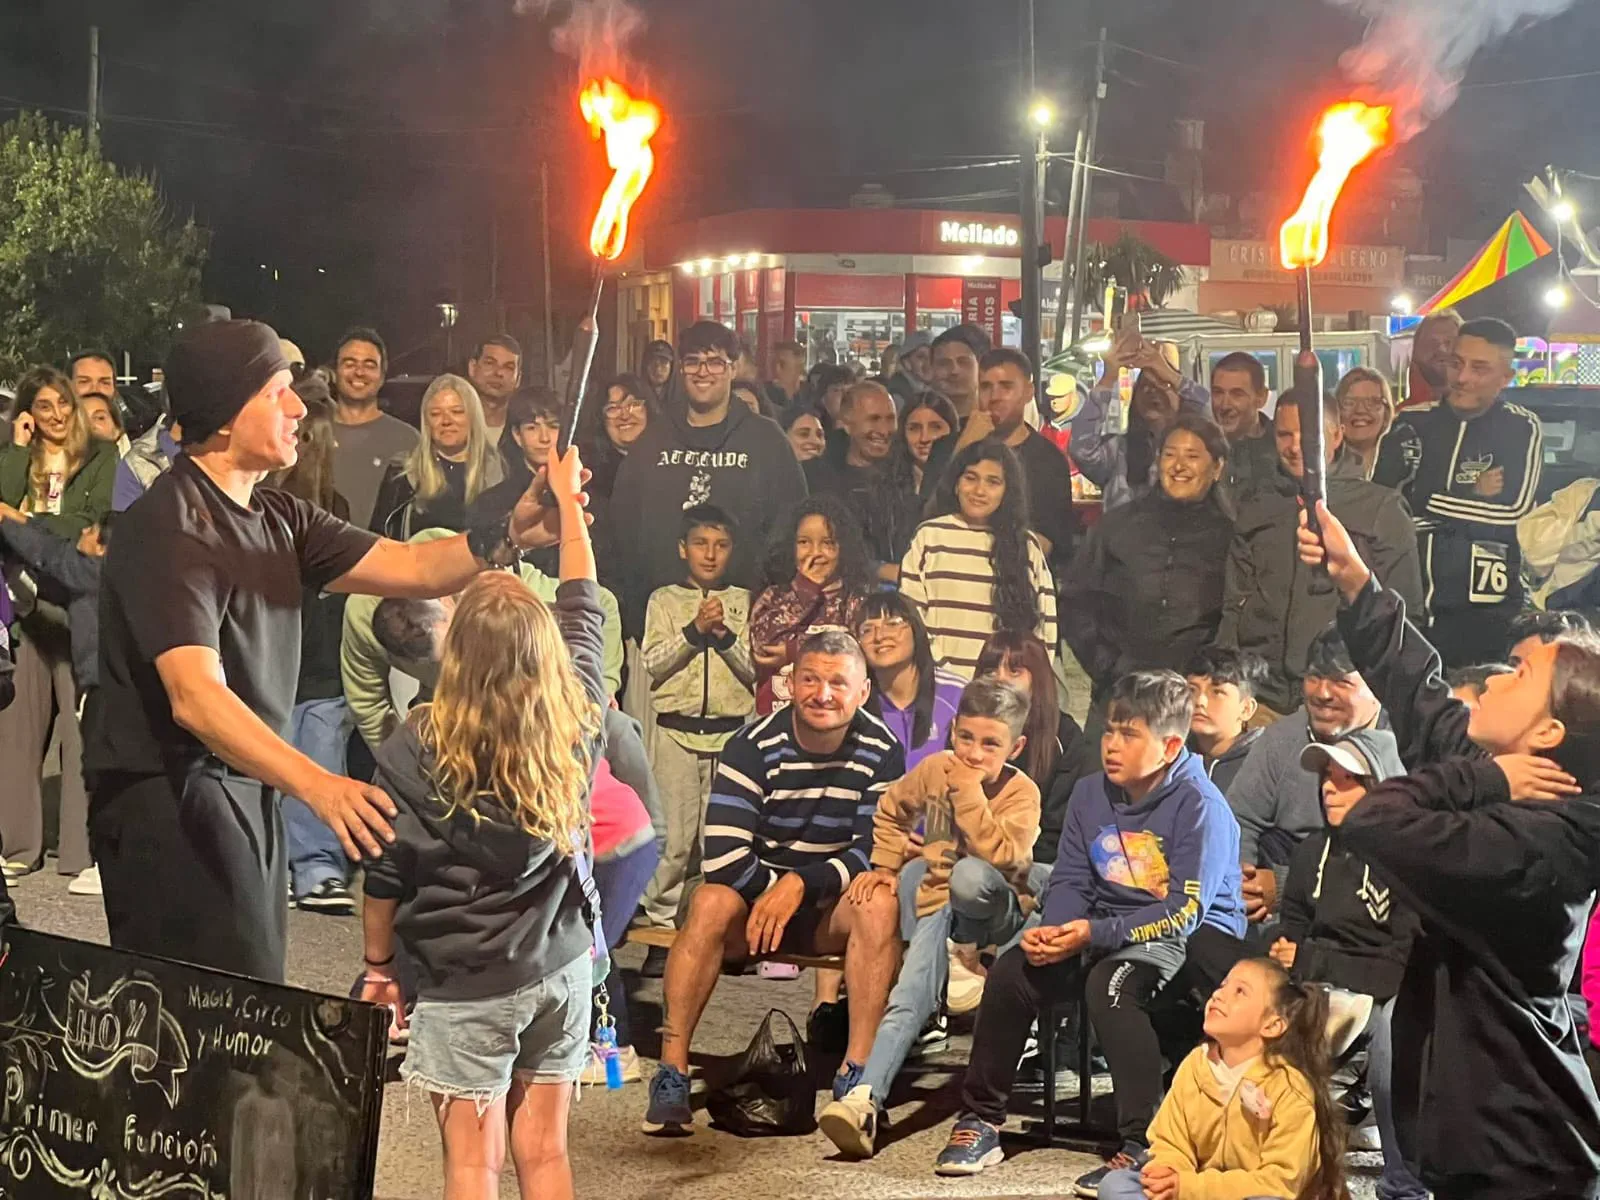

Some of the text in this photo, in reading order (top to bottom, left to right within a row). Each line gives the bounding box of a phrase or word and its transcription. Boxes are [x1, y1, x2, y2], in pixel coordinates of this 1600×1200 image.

[941, 220, 1018, 246] Mellado
[1328, 249, 1388, 268] ALERNO
[657, 449, 749, 469] ATTITUDE
[1476, 559, 1508, 593] 76
[75, 1000, 147, 1053] HOY
